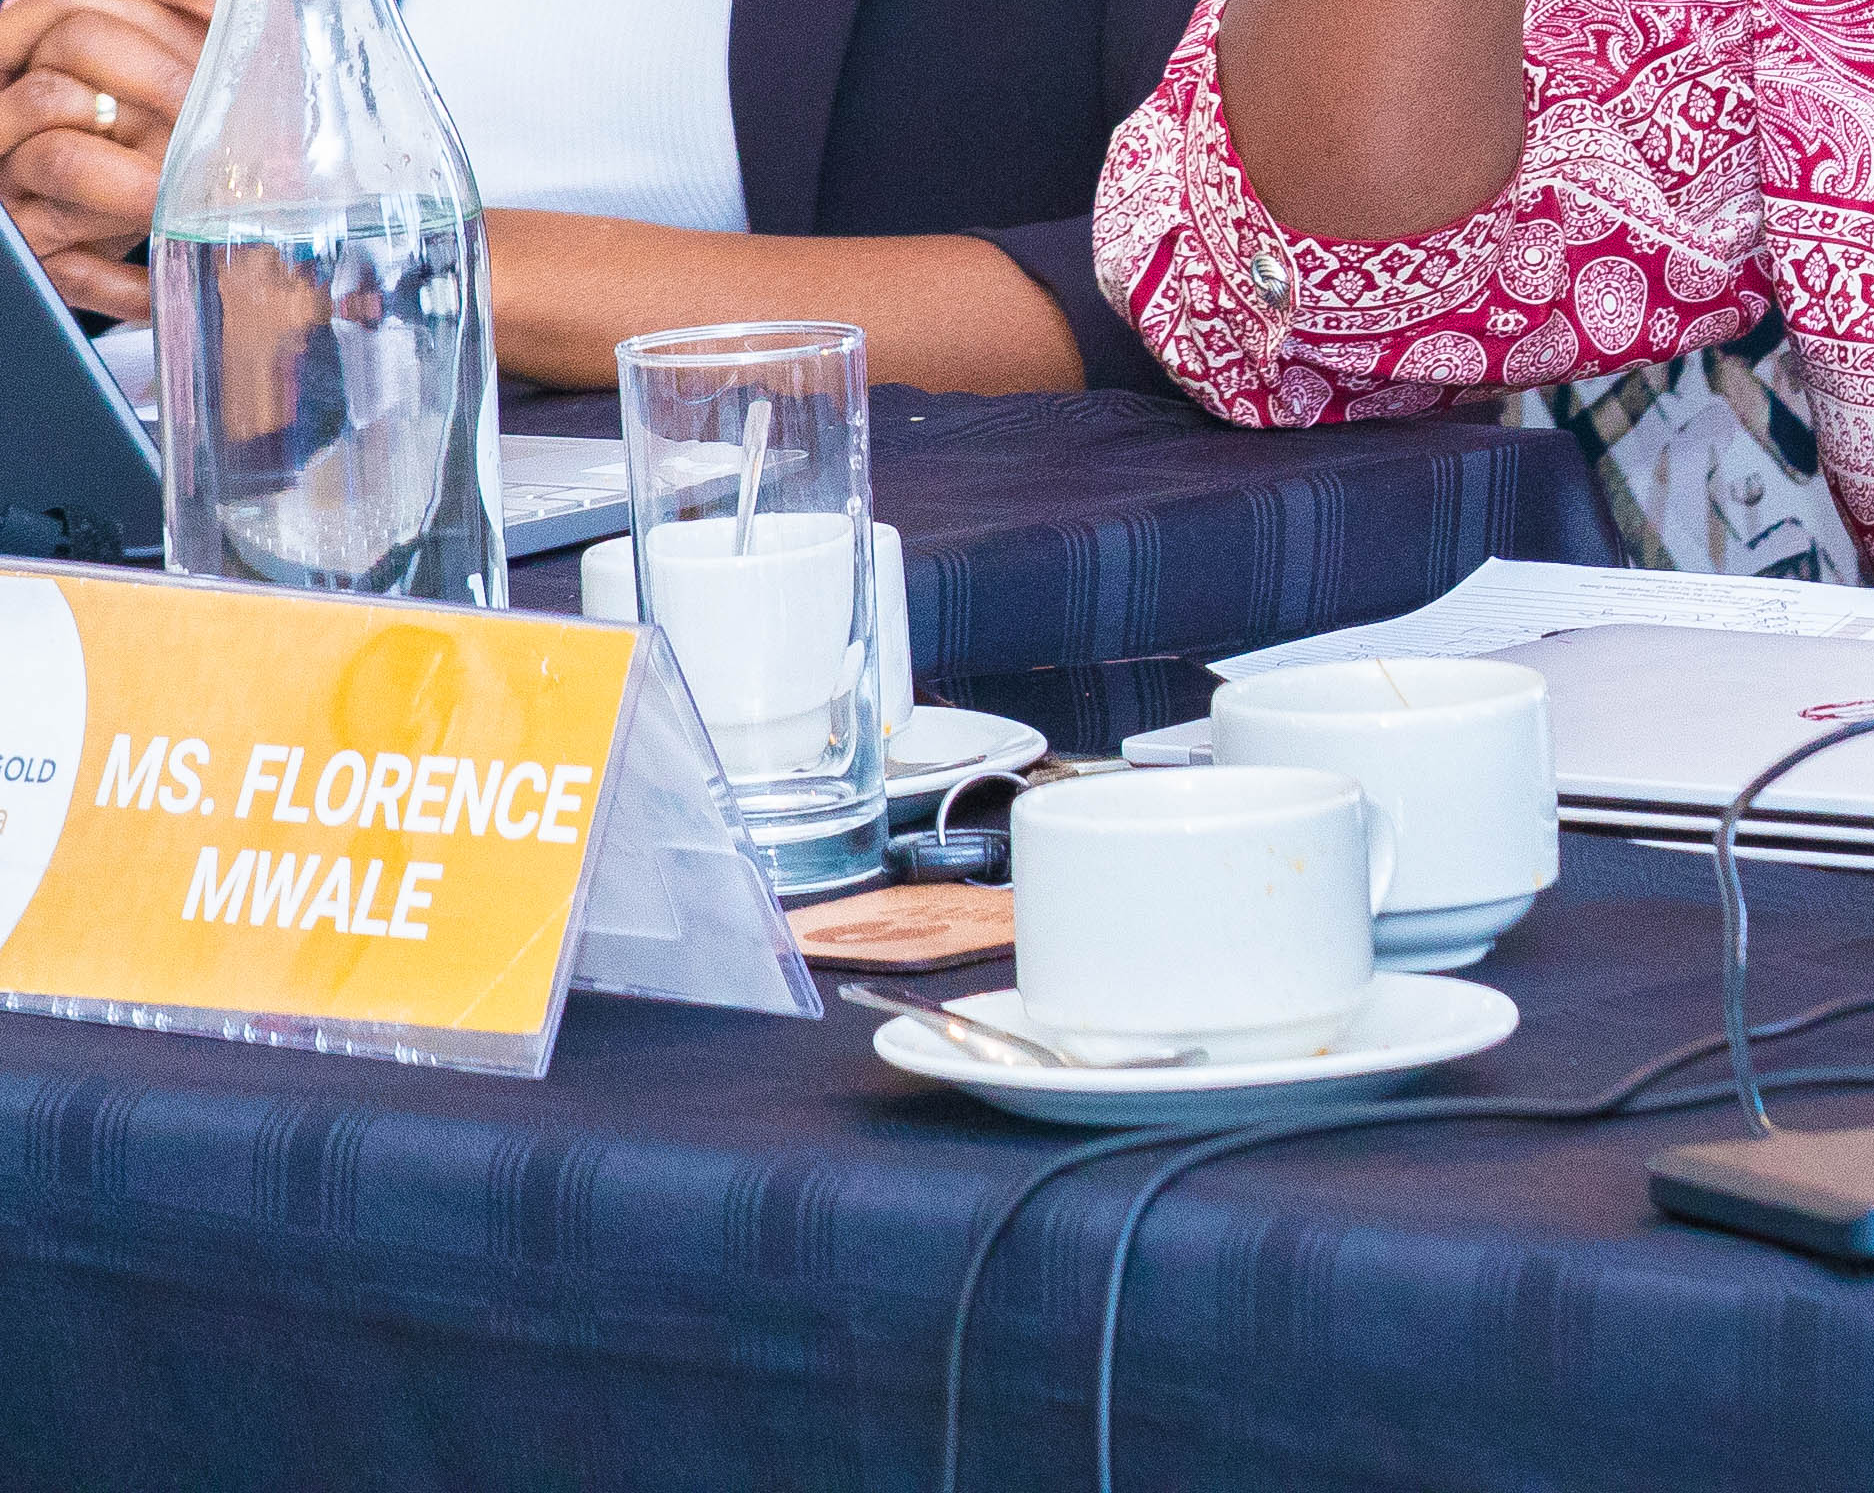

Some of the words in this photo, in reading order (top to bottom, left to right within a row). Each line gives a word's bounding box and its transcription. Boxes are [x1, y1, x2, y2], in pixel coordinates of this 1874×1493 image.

[0, 754, 57, 784] OLD
[94, 732, 215, 817] MS.
[234, 743, 593, 844] FLORENCE
[181, 845, 444, 938] MWALE
